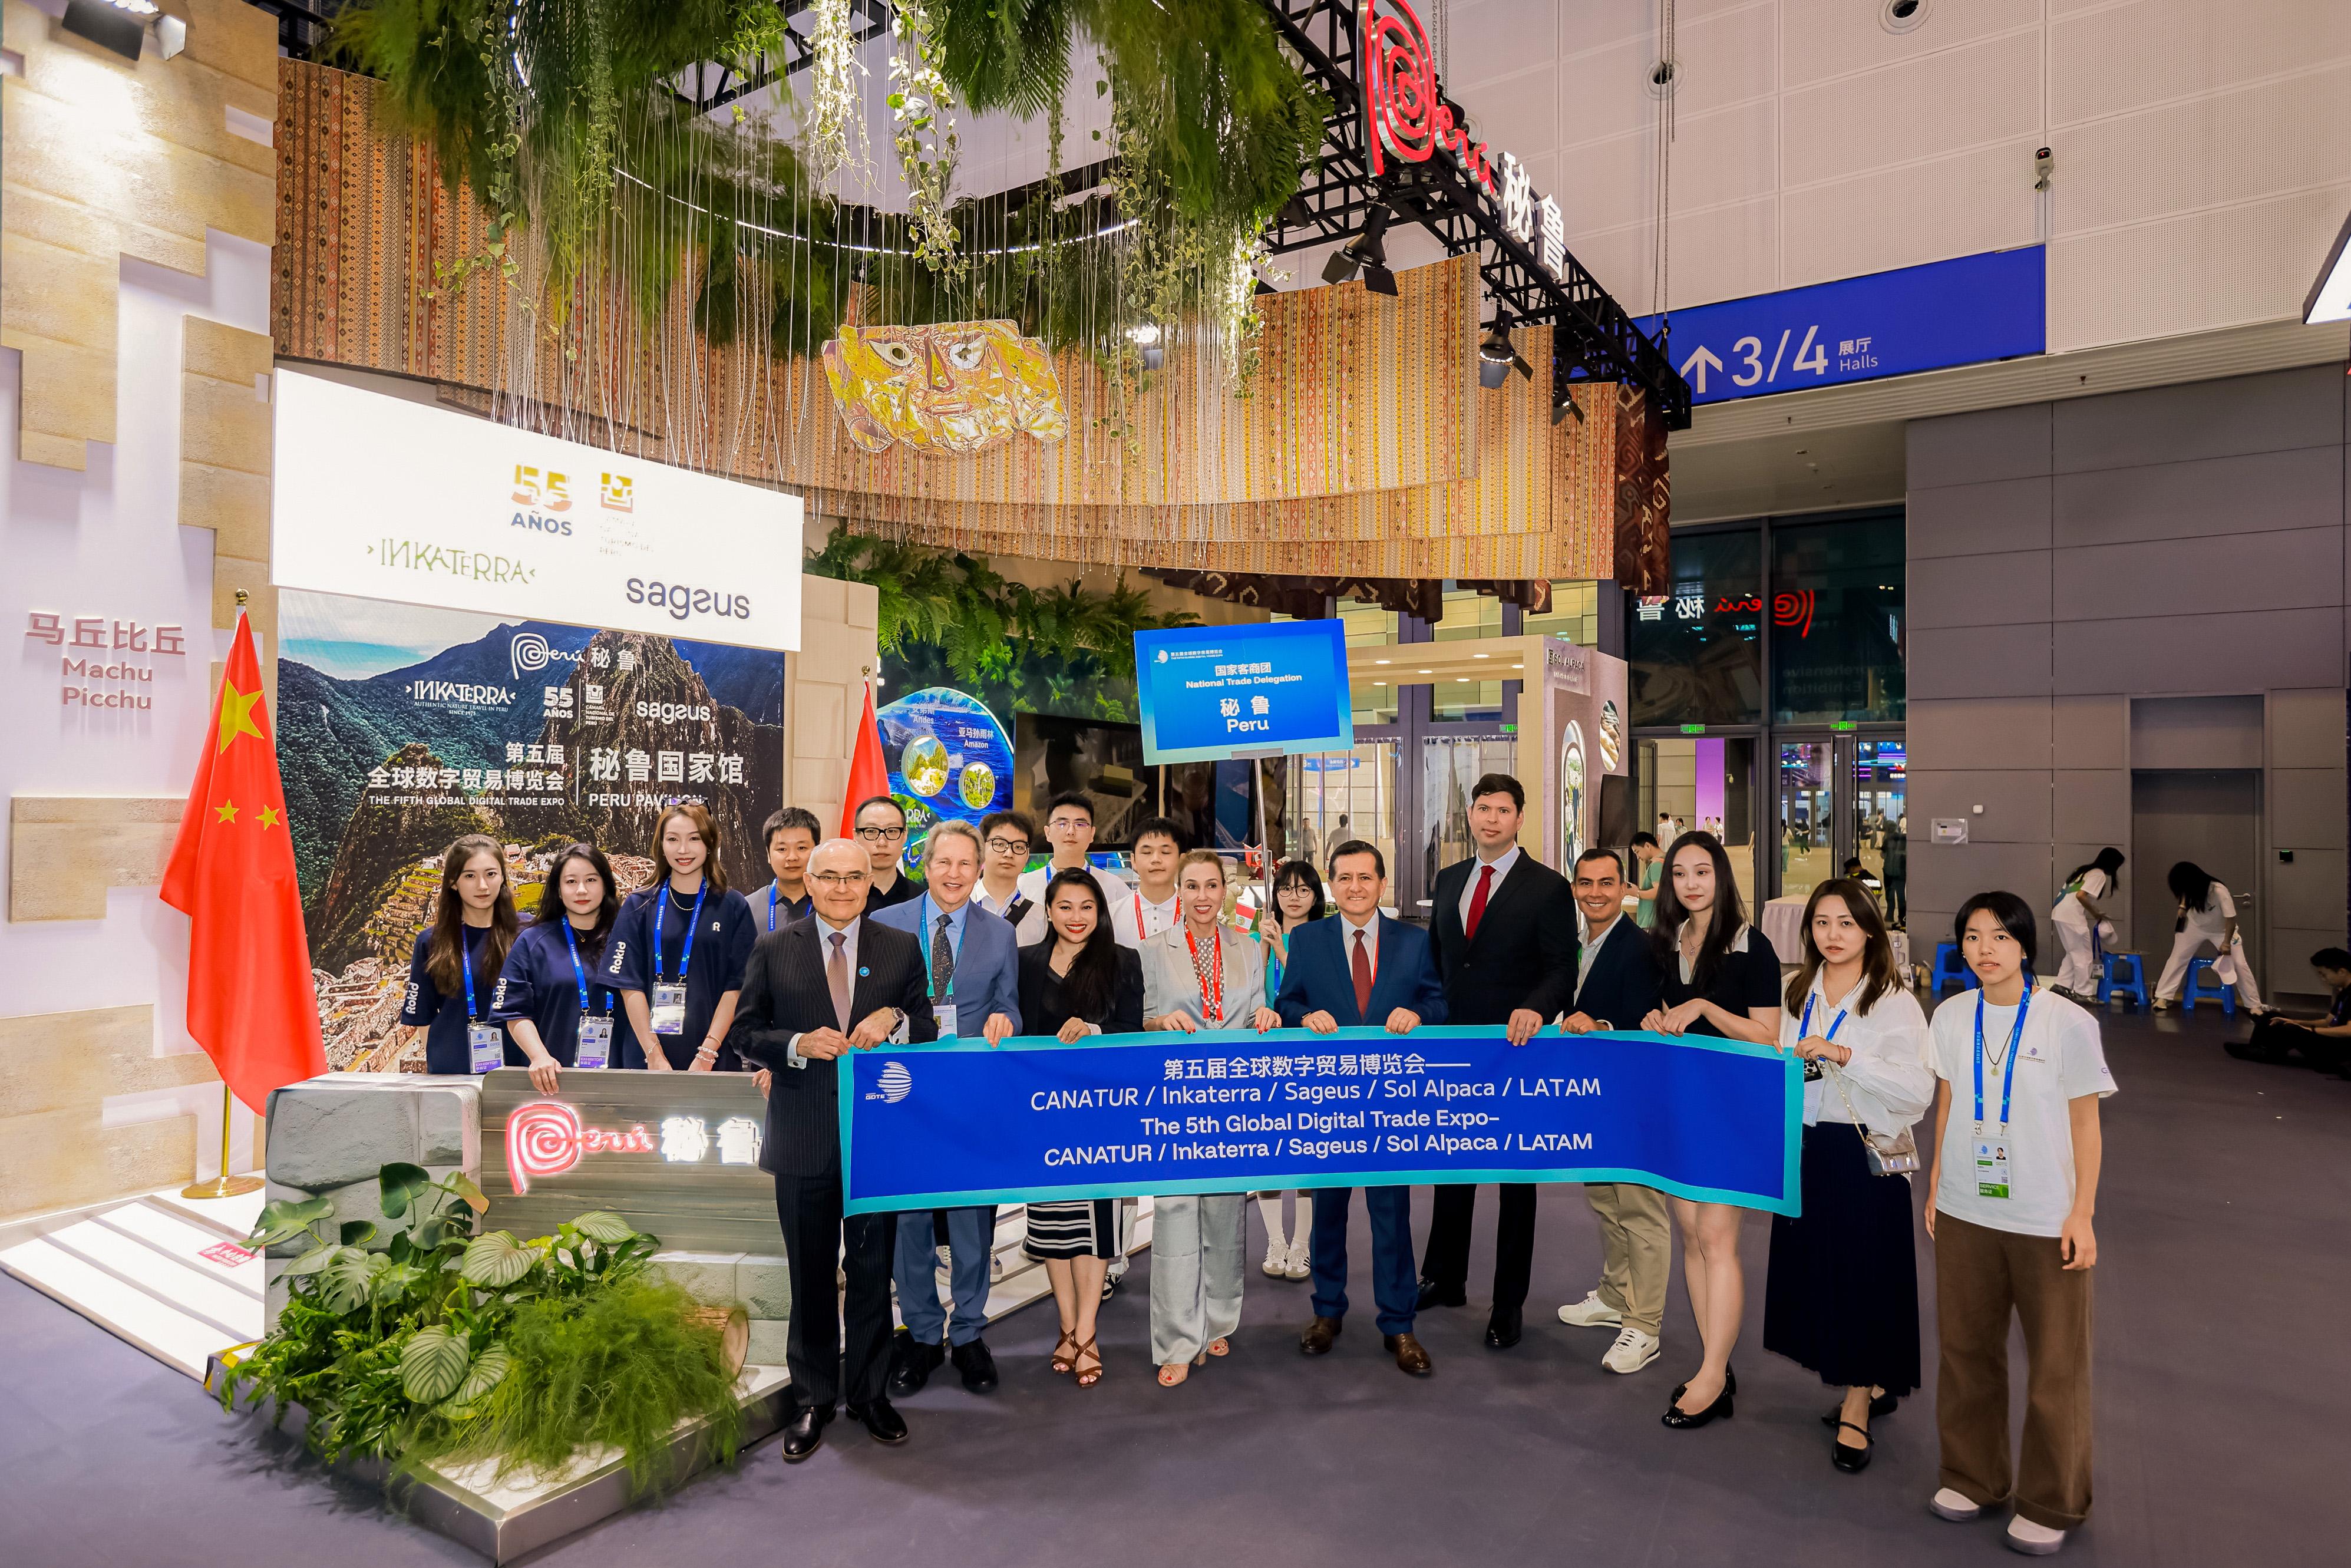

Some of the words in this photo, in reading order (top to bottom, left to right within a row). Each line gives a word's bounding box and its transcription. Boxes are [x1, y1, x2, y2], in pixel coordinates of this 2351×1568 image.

[1498, 151, 1565, 280] 秘鲁
[1732, 325, 1828, 387] 3/4
[1838, 337, 1872, 356] 展厅
[1840, 354, 1878, 372] Halls
[511, 464, 572, 511] 55
[511, 510, 572, 536] AÑOS
[381, 539, 529, 584] INKATERRA
[26, 612, 186, 655] 马丘比丘
[62, 656, 153, 681] Machu
[591, 646, 635, 672] 秘鲁
[1215, 662, 1272, 676] 国家客商团
[1553, 653, 1564, 666] SOL
[414, 680, 511, 705] INKATERRA
[1186, 678, 1224, 688] National
[1226, 676, 1252, 686] Trade
[1254, 674, 1302, 684] Delegation
[62, 686, 151, 709] Picchu
[543, 686, 574, 708] 55
[1220, 695, 1270, 717] 秘鲁
[543, 707, 573, 718] AÑOS
[1227, 718, 1269, 732] Peru
[959, 727, 994, 740] 亚马孙雨林
[964, 740, 989, 749] Amazon
[506, 741, 565, 765] 第五届
[590, 747, 744, 784] 秘鲁国家馆
[367, 765, 564, 791] 全球数字贸易博览会
[369, 795, 390, 805] THE
[394, 795, 423, 806] FIFTH
[427, 796, 465, 806] GLOBAL
[469, 797, 506, 806] DIGITAL
[509, 797, 538, 806] TRADE
[541, 797, 564, 806] EXPO
[589, 793, 630, 807] PERU
[712, 922, 720, 932] R
[610, 941, 626, 975] Rokid
[405, 982, 420, 1014] Rokid
[493, 978, 507, 1009] Rokid
[1031, 1088, 1138, 1110] CANATUR
[1164, 1086, 1260, 1104] Inkaterra
[1285, 1082, 1360, 1104] Sageus
[1385, 1080, 1416, 1097] Sol
[1424, 1080, 1494, 1101] Alpaca
[1520, 1078, 1600, 1096] LATAM
[1141, 1118, 1180, 1135] The
[1186, 1116, 1219, 1133] 5th
[1226, 1113, 1291, 1132] Global
[1299, 1111, 1364, 1133] Digital
[1371, 1110, 1430, 1127] Trade
[1045, 1144, 1151, 1166] CANATUR
[1173, 1142, 1269, 1160] Inkaterra
[1289, 1138, 1367, 1158] Sageus
[1387, 1135, 1418, 1151] Sol
[1425, 1134, 1498, 1154] Alpaca
[1519, 1134, 1591, 1150] LATAM
